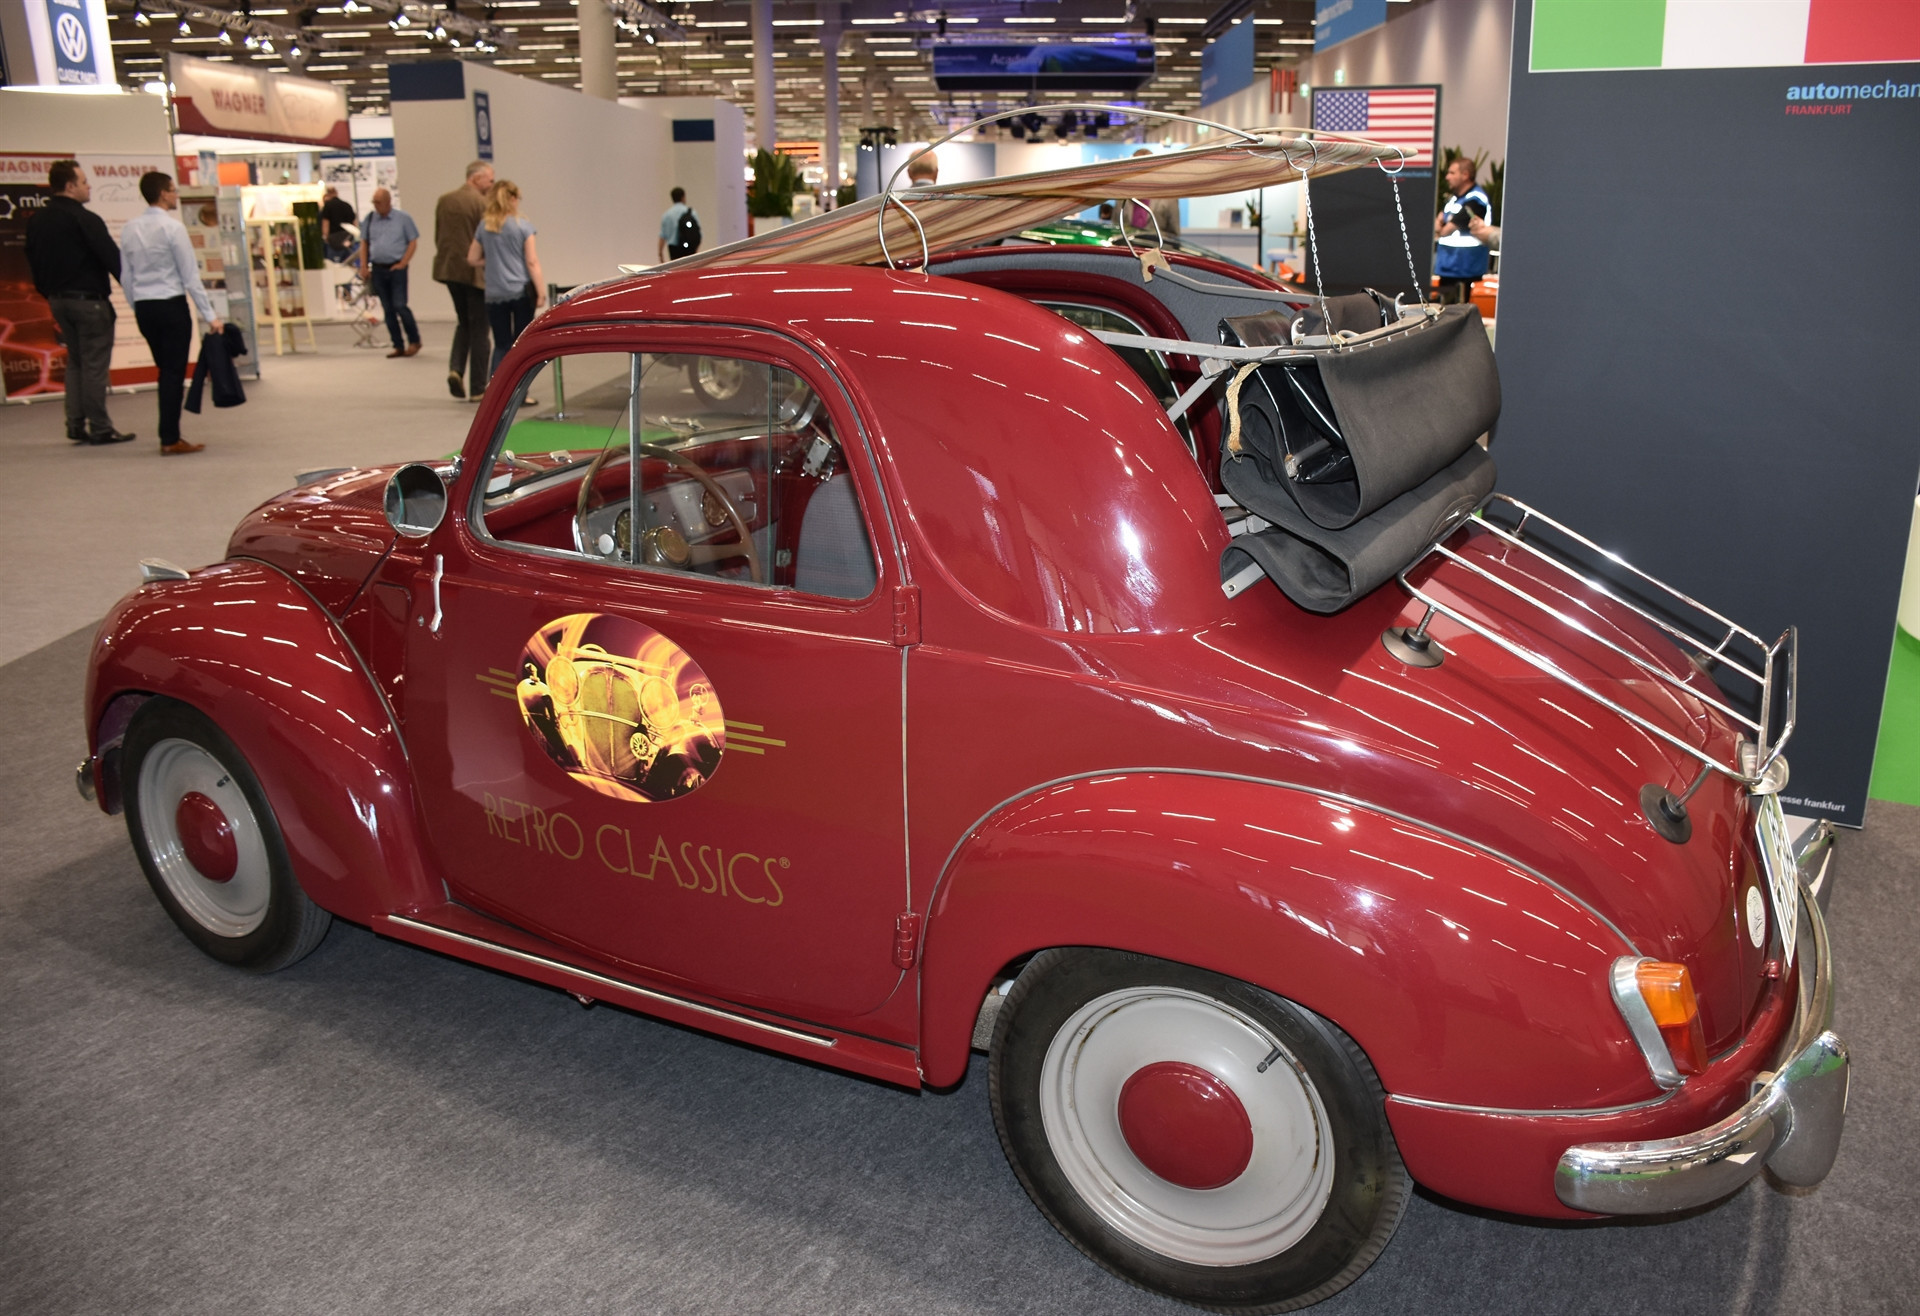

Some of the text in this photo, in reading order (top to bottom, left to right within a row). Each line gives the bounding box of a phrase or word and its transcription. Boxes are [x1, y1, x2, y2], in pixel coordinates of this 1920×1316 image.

[1786, 79, 1920, 100] automechan
[211, 89, 267, 115] WAGNER
[1785, 103, 1852, 116] FRANKFURT
[1803, 797, 1846, 811] frankfurt
[484, 791, 584, 861] RETRO
